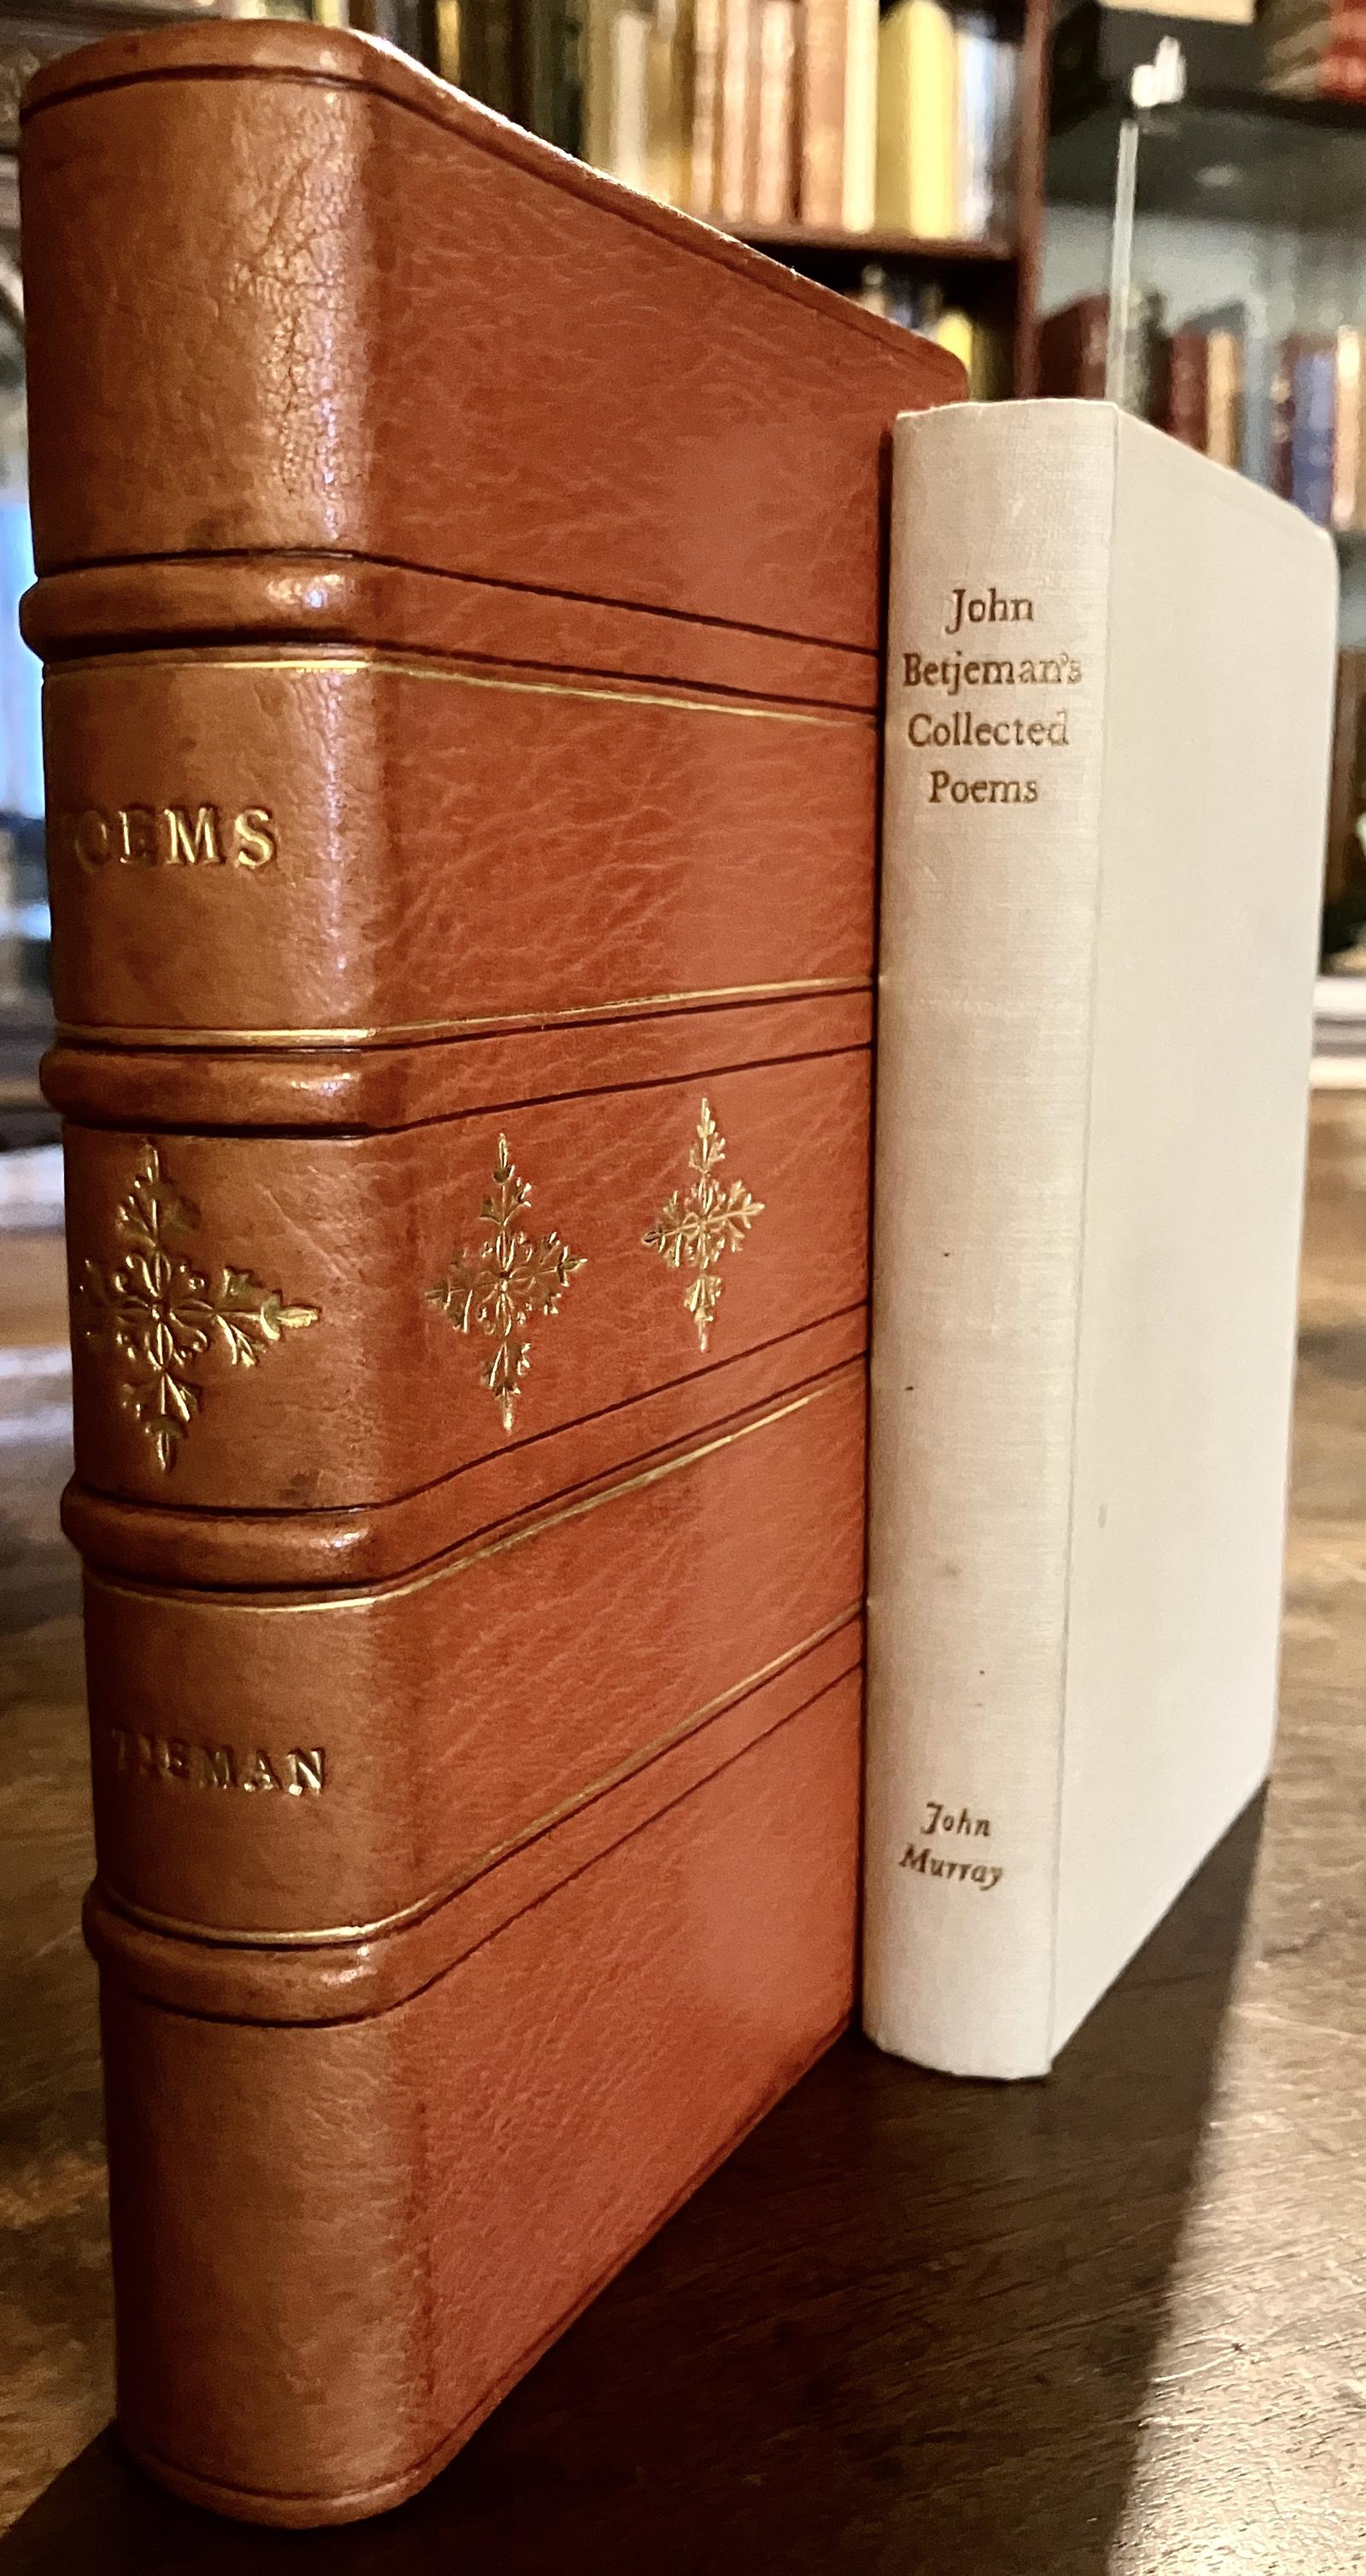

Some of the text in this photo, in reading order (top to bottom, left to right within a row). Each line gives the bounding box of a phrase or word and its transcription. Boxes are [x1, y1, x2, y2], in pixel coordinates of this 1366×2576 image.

[944, 587, 1034, 634] John
[902, 650, 1083, 696] Betjeman's
[908, 709, 1069, 747] Collected
[928, 770, 1038, 803] Poems
[58, 806, 275, 872] OEMS
[919, 1801, 990, 1837] John
[898, 1842, 1004, 1891] Murray
